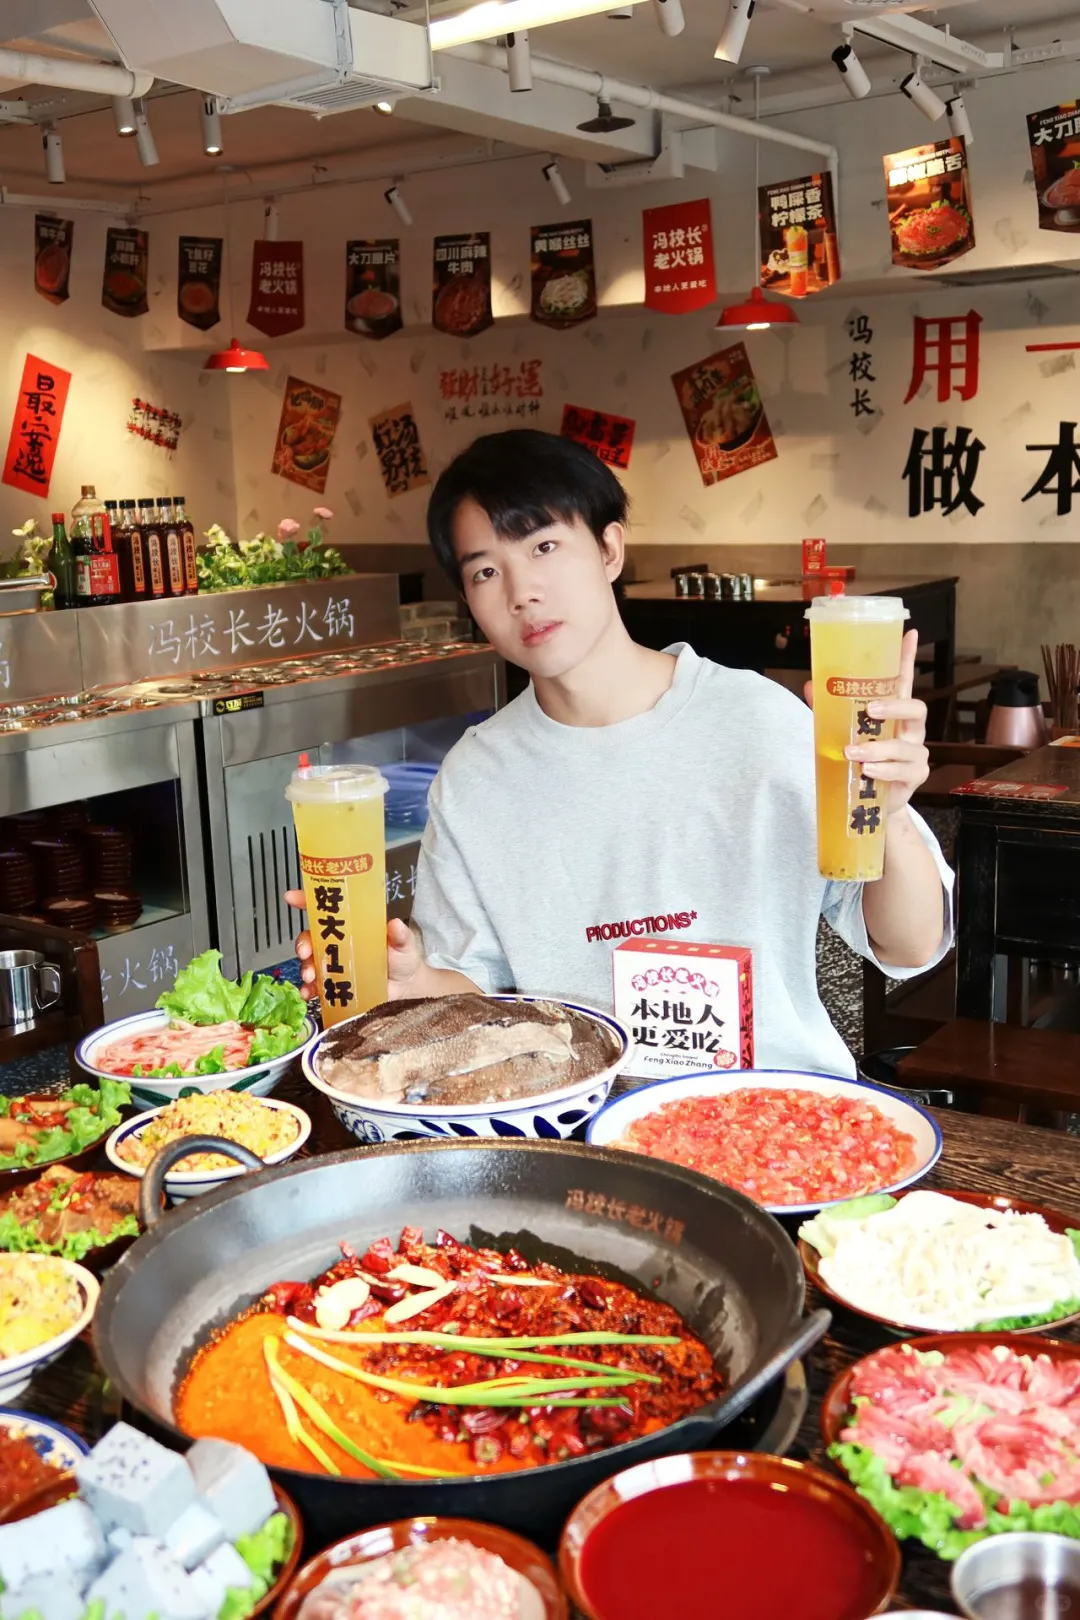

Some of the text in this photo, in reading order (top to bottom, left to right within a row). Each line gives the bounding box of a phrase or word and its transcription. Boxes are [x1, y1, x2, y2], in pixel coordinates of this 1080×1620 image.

[771, 204, 823, 227] 柠檬茶
[652, 226, 703, 250] 冯校长
[259, 261, 298, 278] 冯校长
[653, 247, 705, 270] 老火锅
[259, 279, 298, 295] 老火锅
[849, 314, 877, 417] 冯校长
[148, 596, 355, 664] 冯校长老火锅
[850, 710, 885, 836] 好1杯
[300, 855, 368, 875] 校长老火锅
[314, 885, 354, 1008] 好大1杯
[630, 998, 725, 1028] 本地人
[643, 1055, 713, 1070] Feng Xiao Zhang
